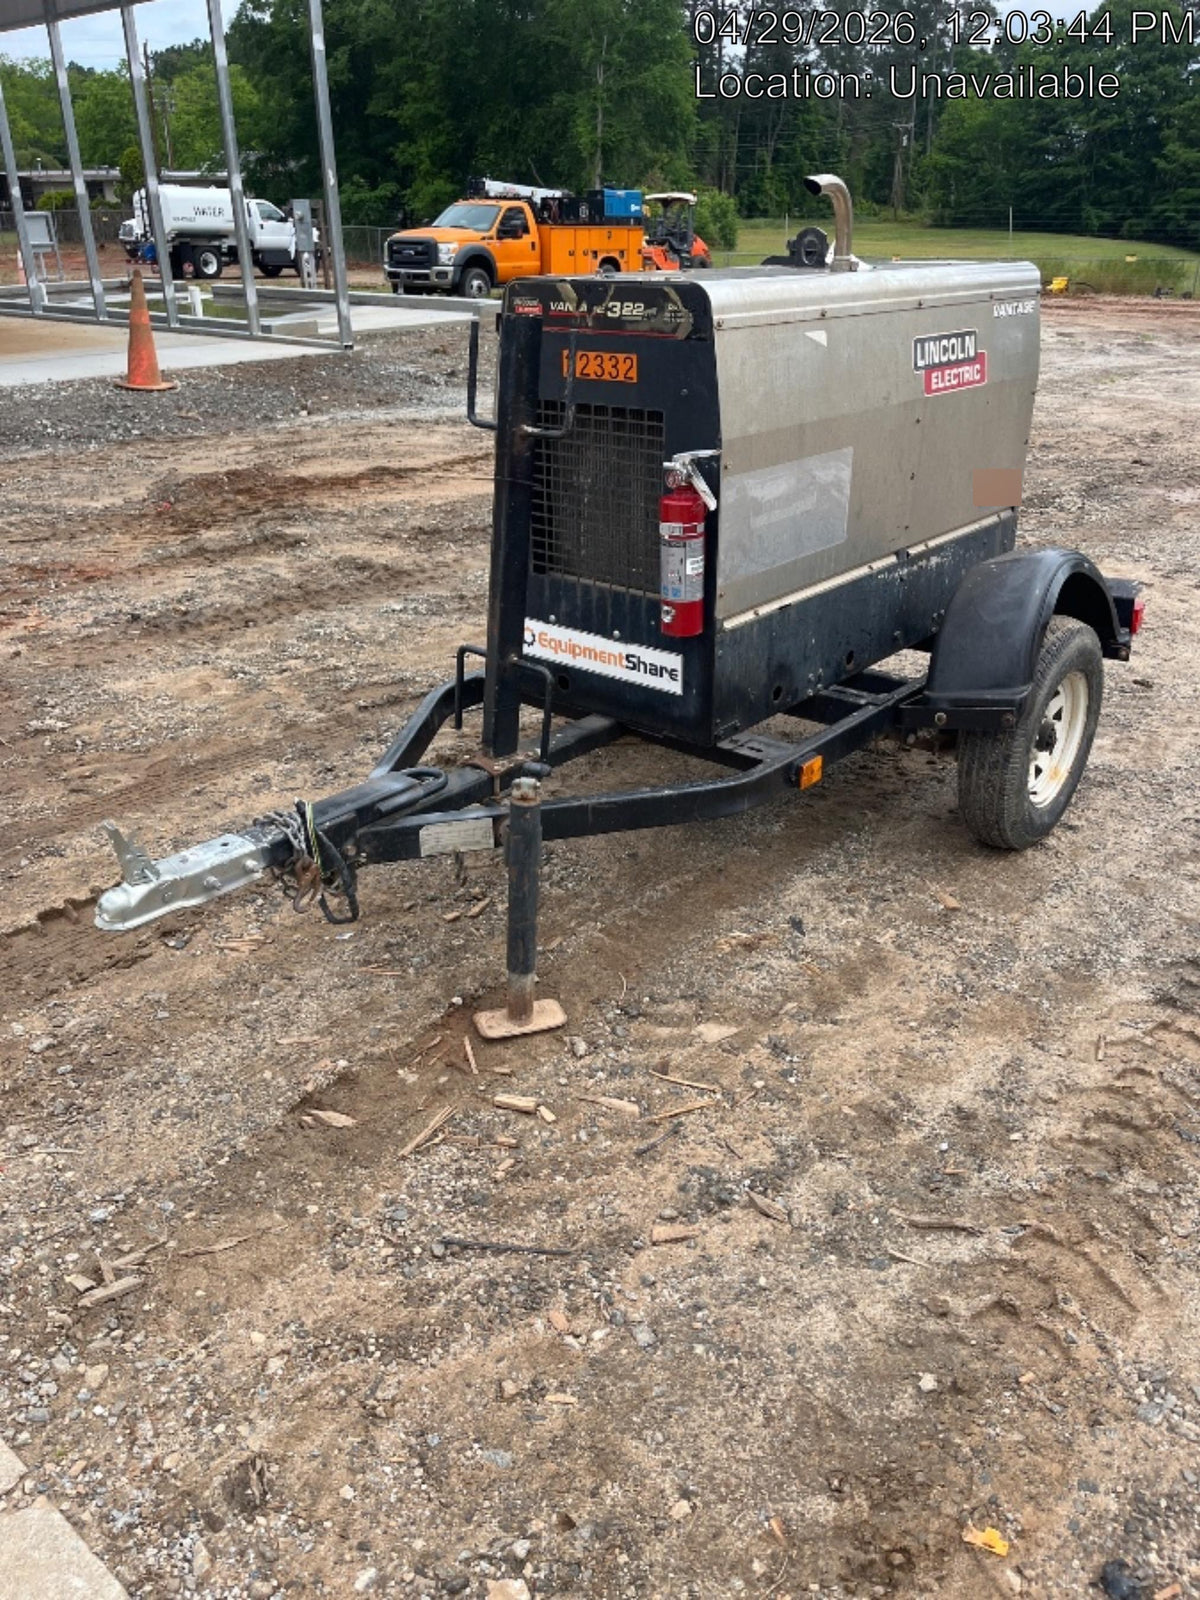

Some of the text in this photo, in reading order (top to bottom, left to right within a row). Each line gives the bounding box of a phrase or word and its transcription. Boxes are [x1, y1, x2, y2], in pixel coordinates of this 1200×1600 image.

[193, 206, 224, 217] WATER
[607, 301, 644, 317] 322
[917, 335, 975, 366] LINCOLN
[931, 364, 981, 390] ELECTRIC
[538, 632, 679, 682] EquipmentShare
